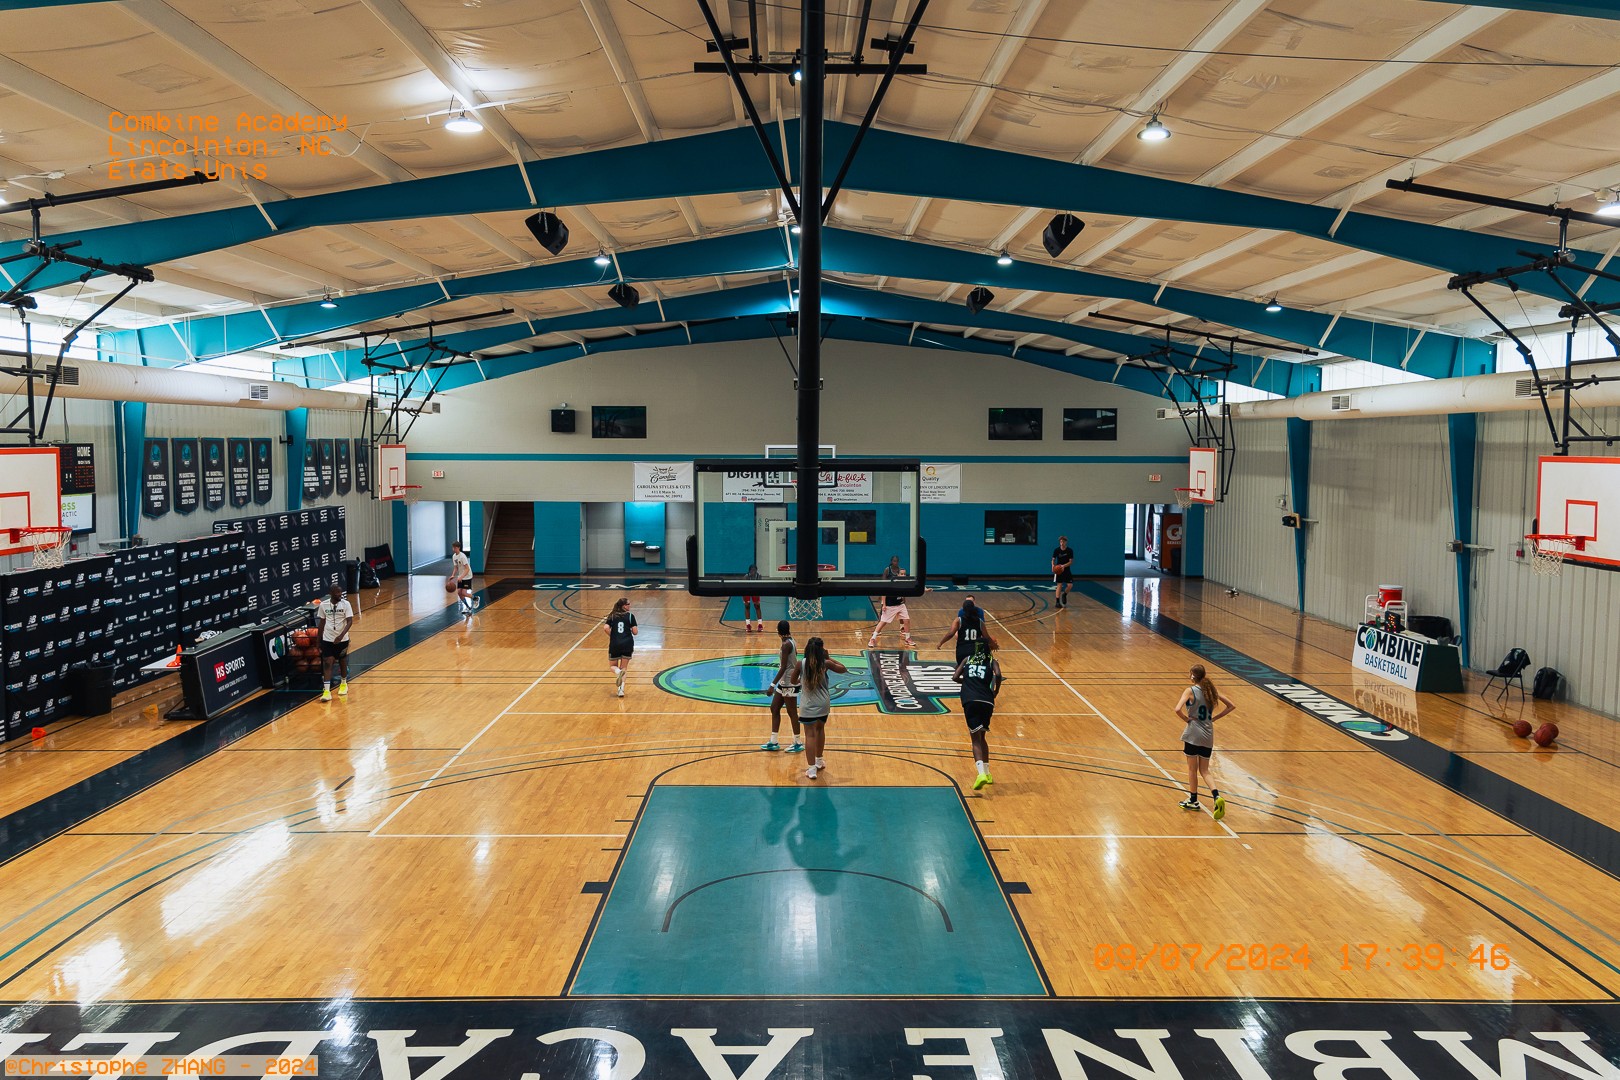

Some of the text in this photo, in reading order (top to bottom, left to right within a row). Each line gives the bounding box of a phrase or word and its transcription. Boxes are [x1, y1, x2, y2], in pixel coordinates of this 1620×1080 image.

[77, 447, 91, 457] HOME
[617, 622, 625, 633] 8
[964, 629, 977, 640] 10
[1357, 626, 1422, 666] COMBINE
[216, 656, 246, 679] HS SPORTS
[968, 664, 986, 679] 25
[1364, 653, 1408, 680] BASKETBALL
